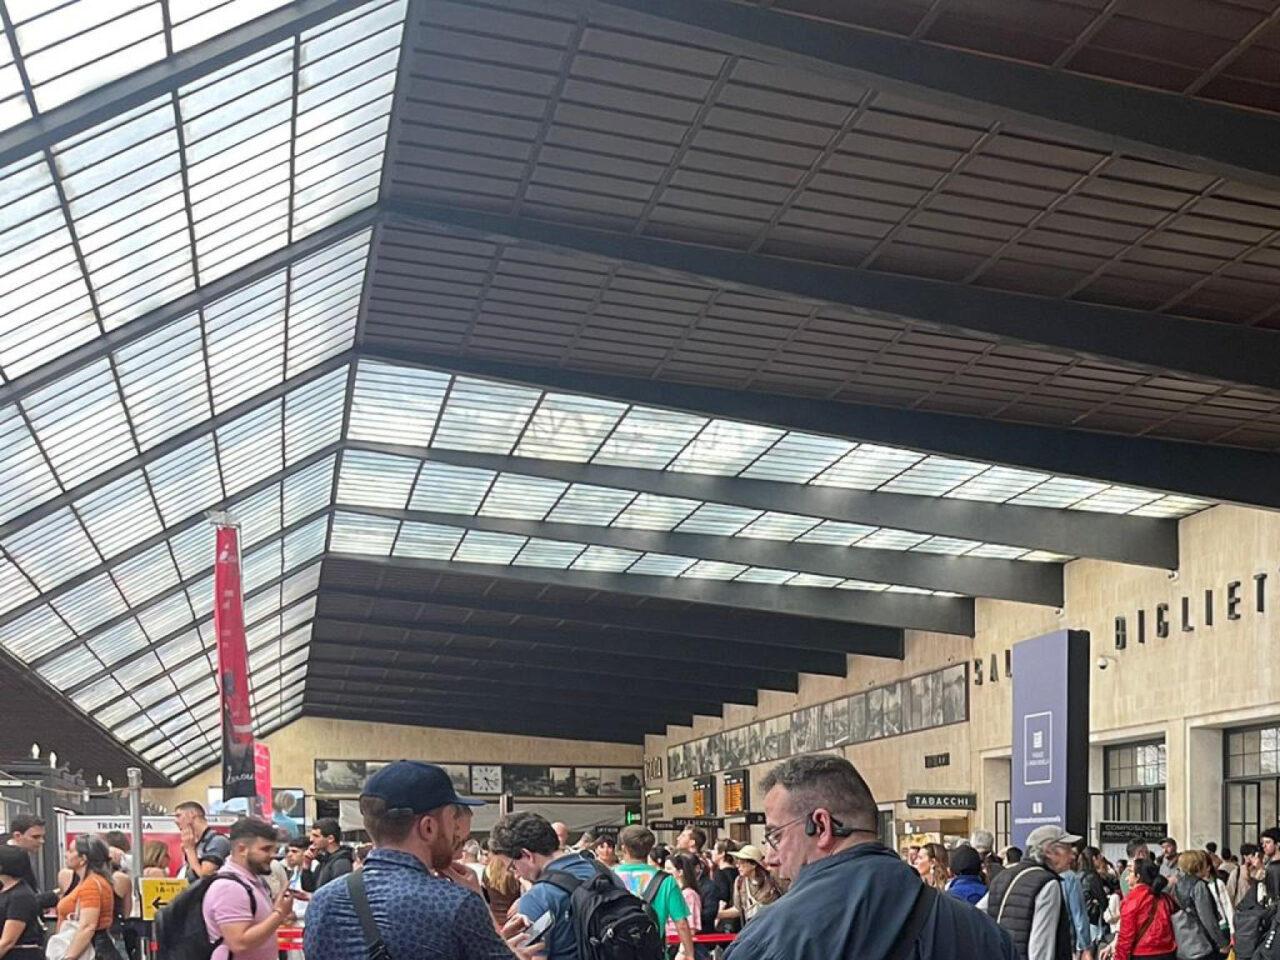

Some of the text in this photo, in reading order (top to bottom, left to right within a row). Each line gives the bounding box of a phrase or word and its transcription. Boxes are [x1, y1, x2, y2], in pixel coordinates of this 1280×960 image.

[974, 649, 1013, 686] SAL
[914, 796, 969, 806] TABACCHI
[96, 821, 153, 831] TRENITIA
